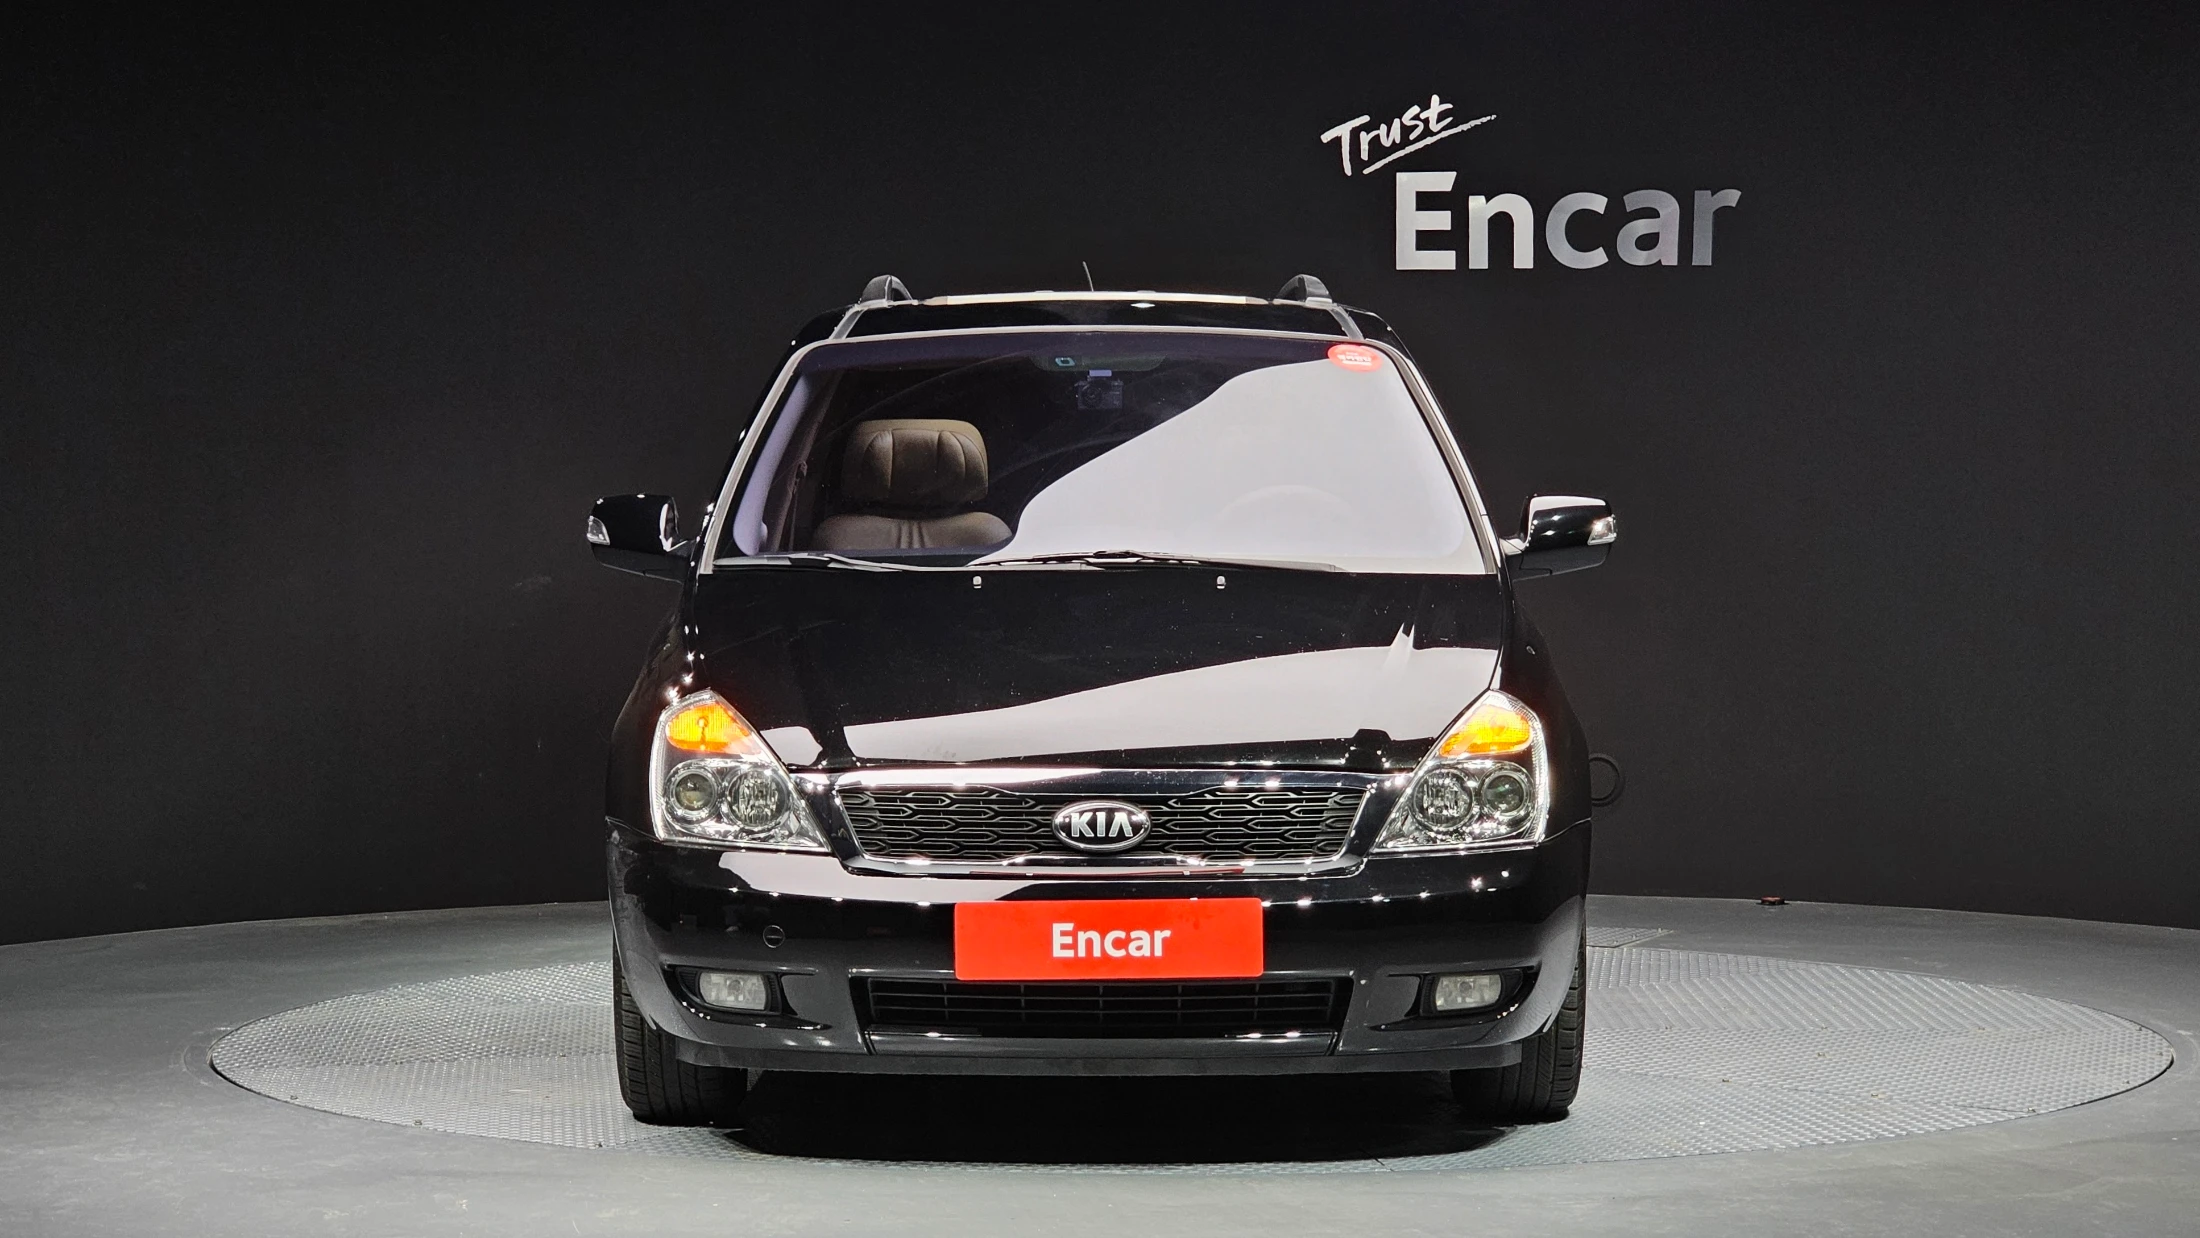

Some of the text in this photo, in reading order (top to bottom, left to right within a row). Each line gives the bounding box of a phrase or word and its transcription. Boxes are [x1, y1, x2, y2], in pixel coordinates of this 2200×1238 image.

[1320, 94, 1454, 176] Trust
[1395, 171, 1742, 271] Encar
[1070, 811, 1134, 838] KIA
[1051, 922, 1172, 959] Encar
